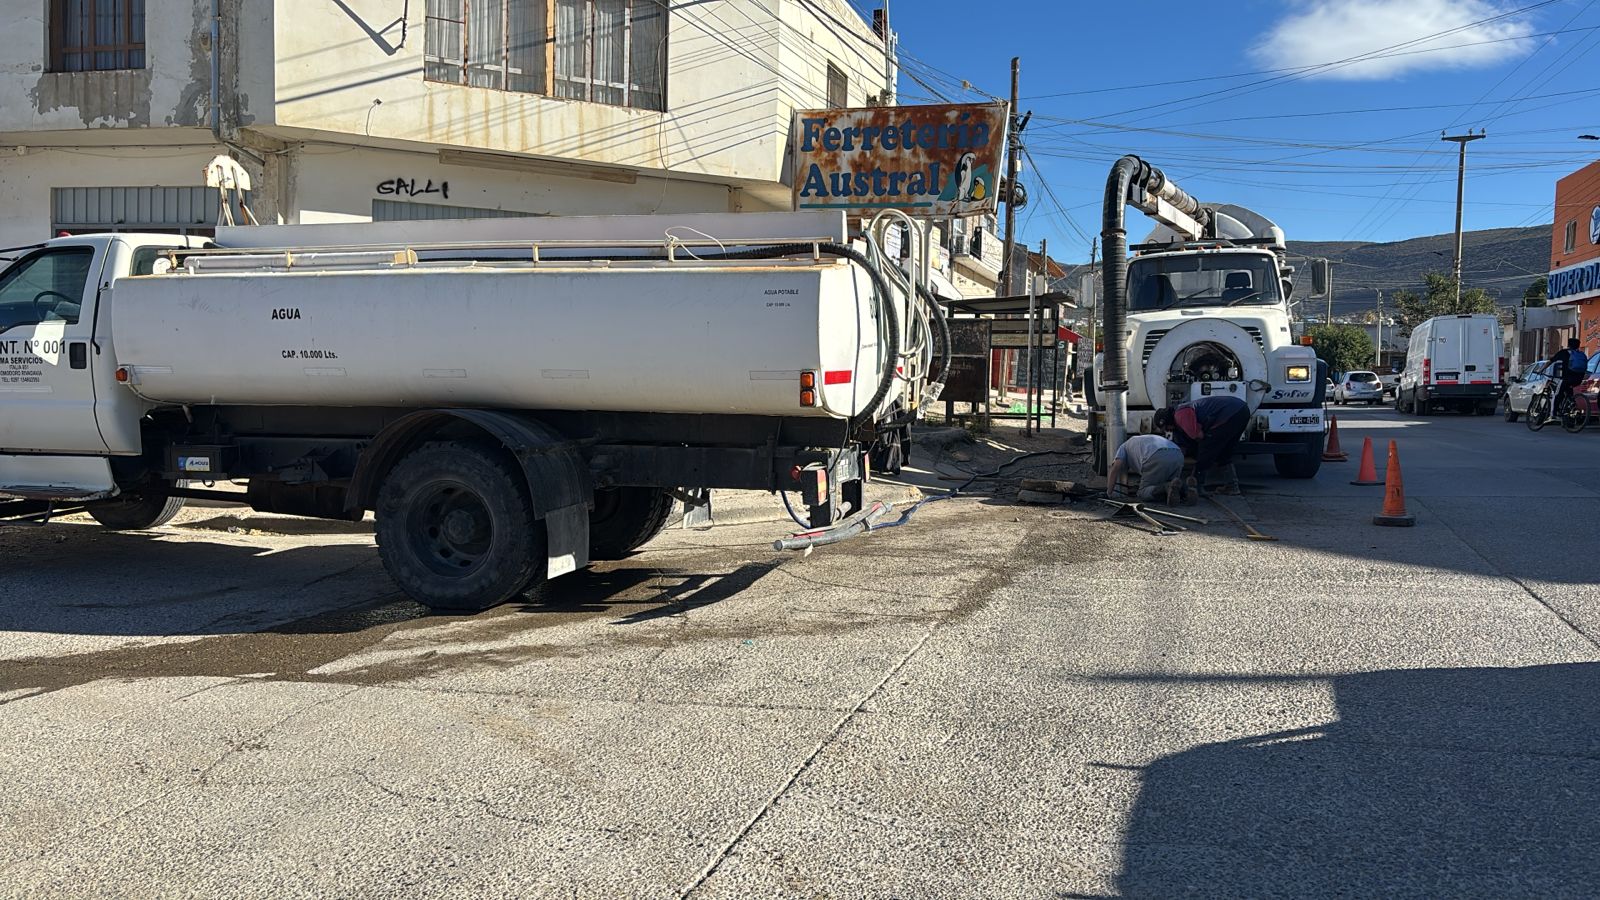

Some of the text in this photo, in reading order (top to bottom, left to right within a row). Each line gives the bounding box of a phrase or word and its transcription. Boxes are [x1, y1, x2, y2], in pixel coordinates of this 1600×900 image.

[800, 112, 989, 152] Ferretería
[800, 162, 941, 197] Austral
[1547, 267, 1582, 299] SUPER
[271, 308, 301, 320] AGUA
[43, 340, 66, 354] 001
[10, 356, 43, 364] SERVICIOS
[281, 350, 338, 359] CAP. 10.000 Lts.
